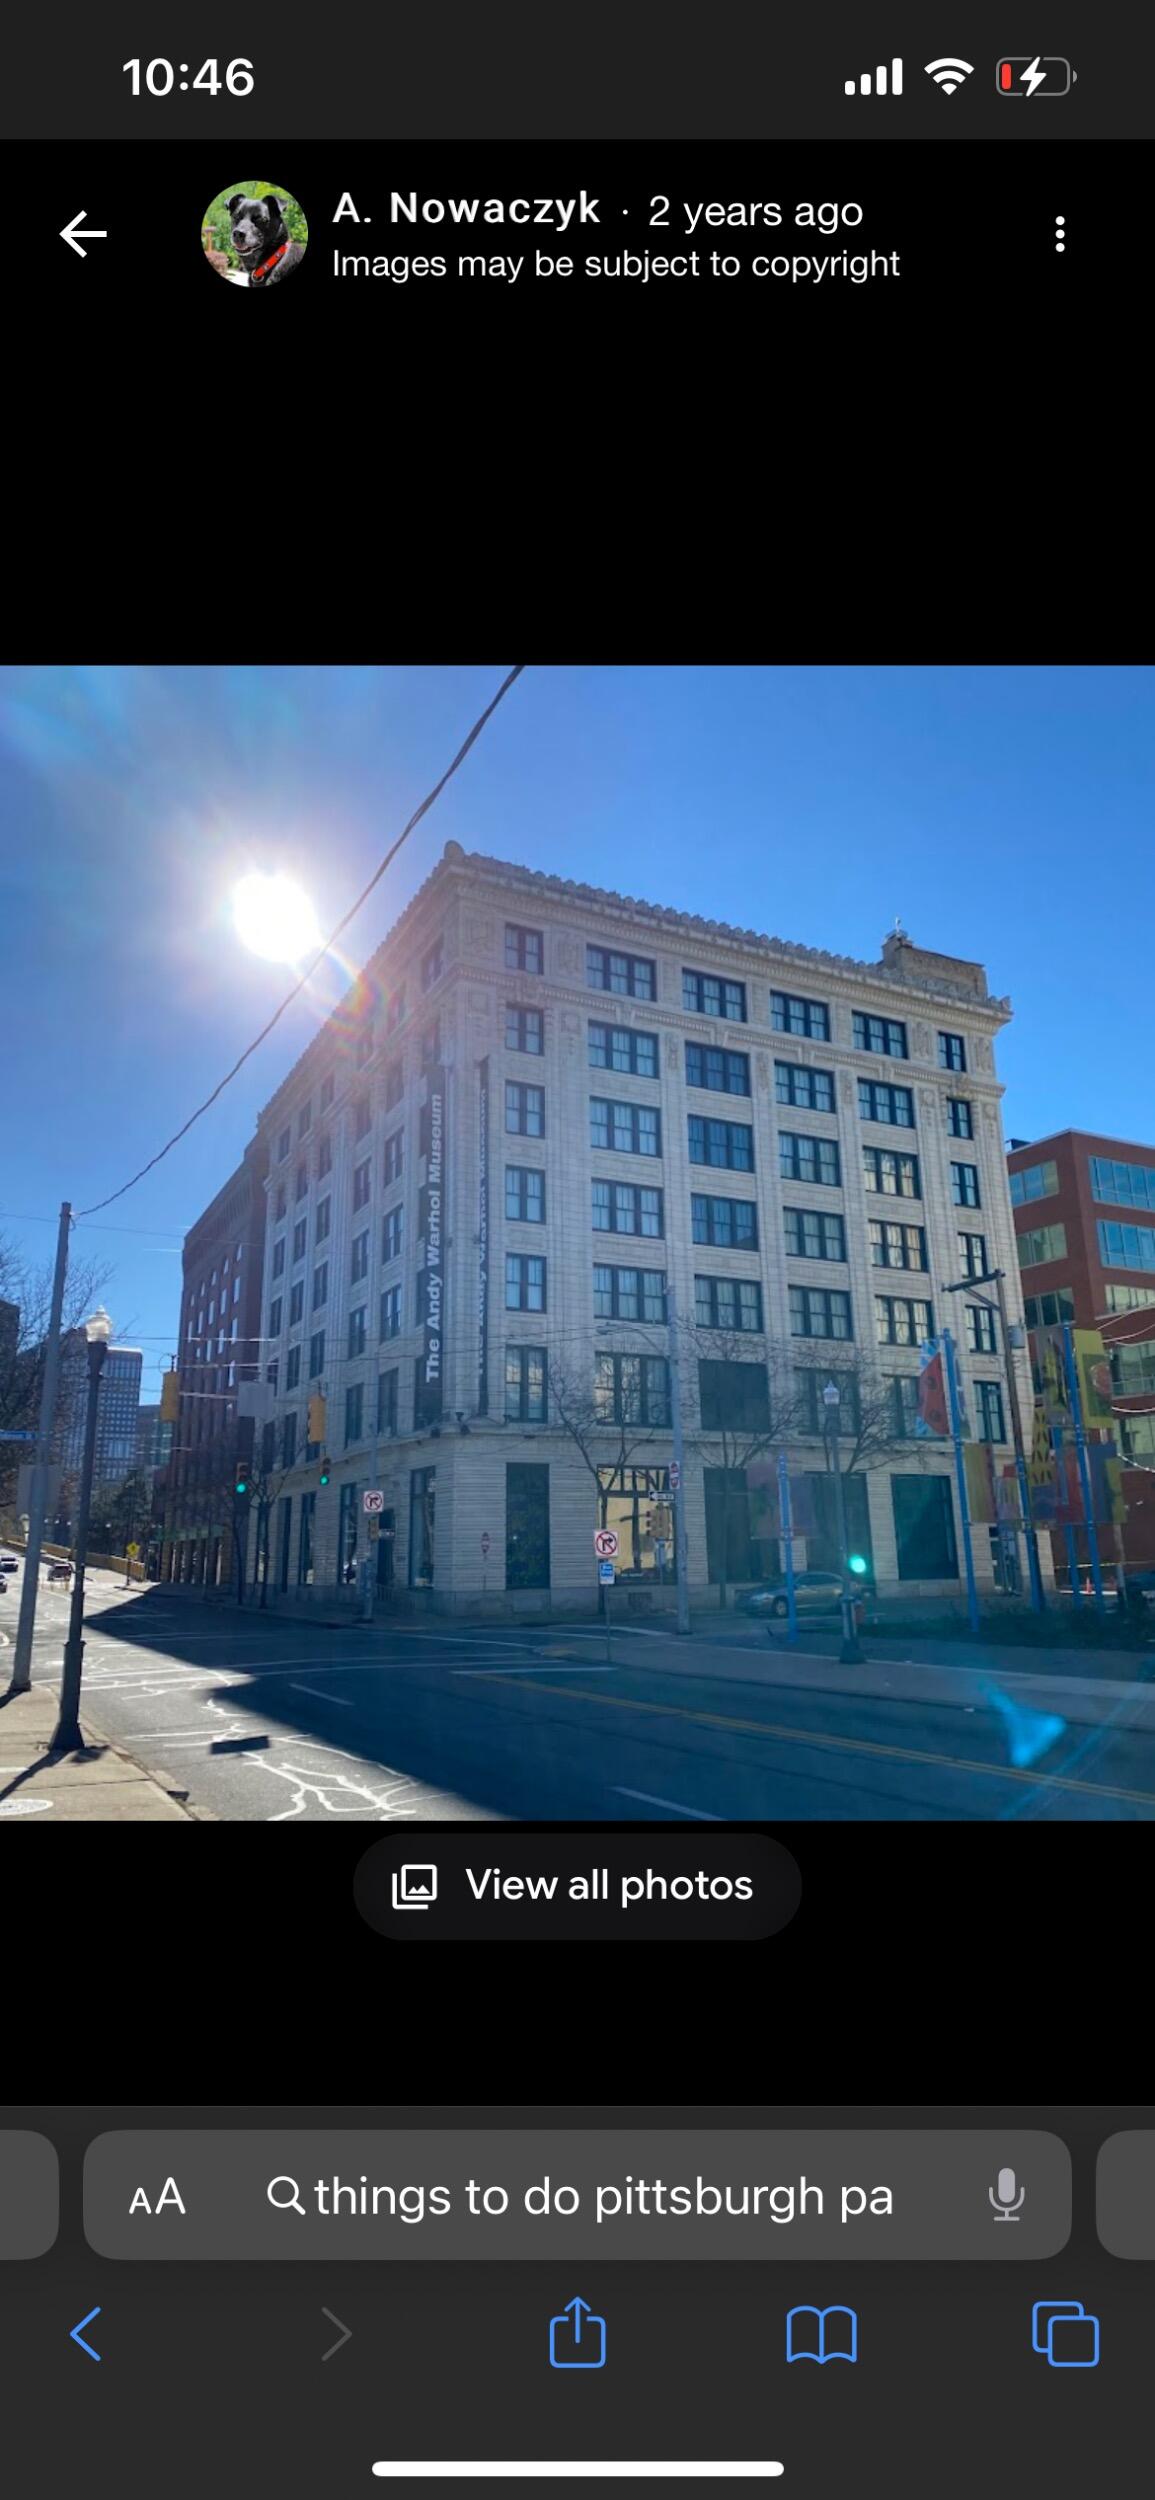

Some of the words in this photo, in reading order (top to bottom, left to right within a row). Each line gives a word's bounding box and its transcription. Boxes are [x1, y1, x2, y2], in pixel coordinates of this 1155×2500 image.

[428, 1094, 442, 1183] Museum
[426, 1190, 441, 1267] Warhol
[426, 1272, 443, 1330] Andy
[426, 1338, 440, 1383] The
